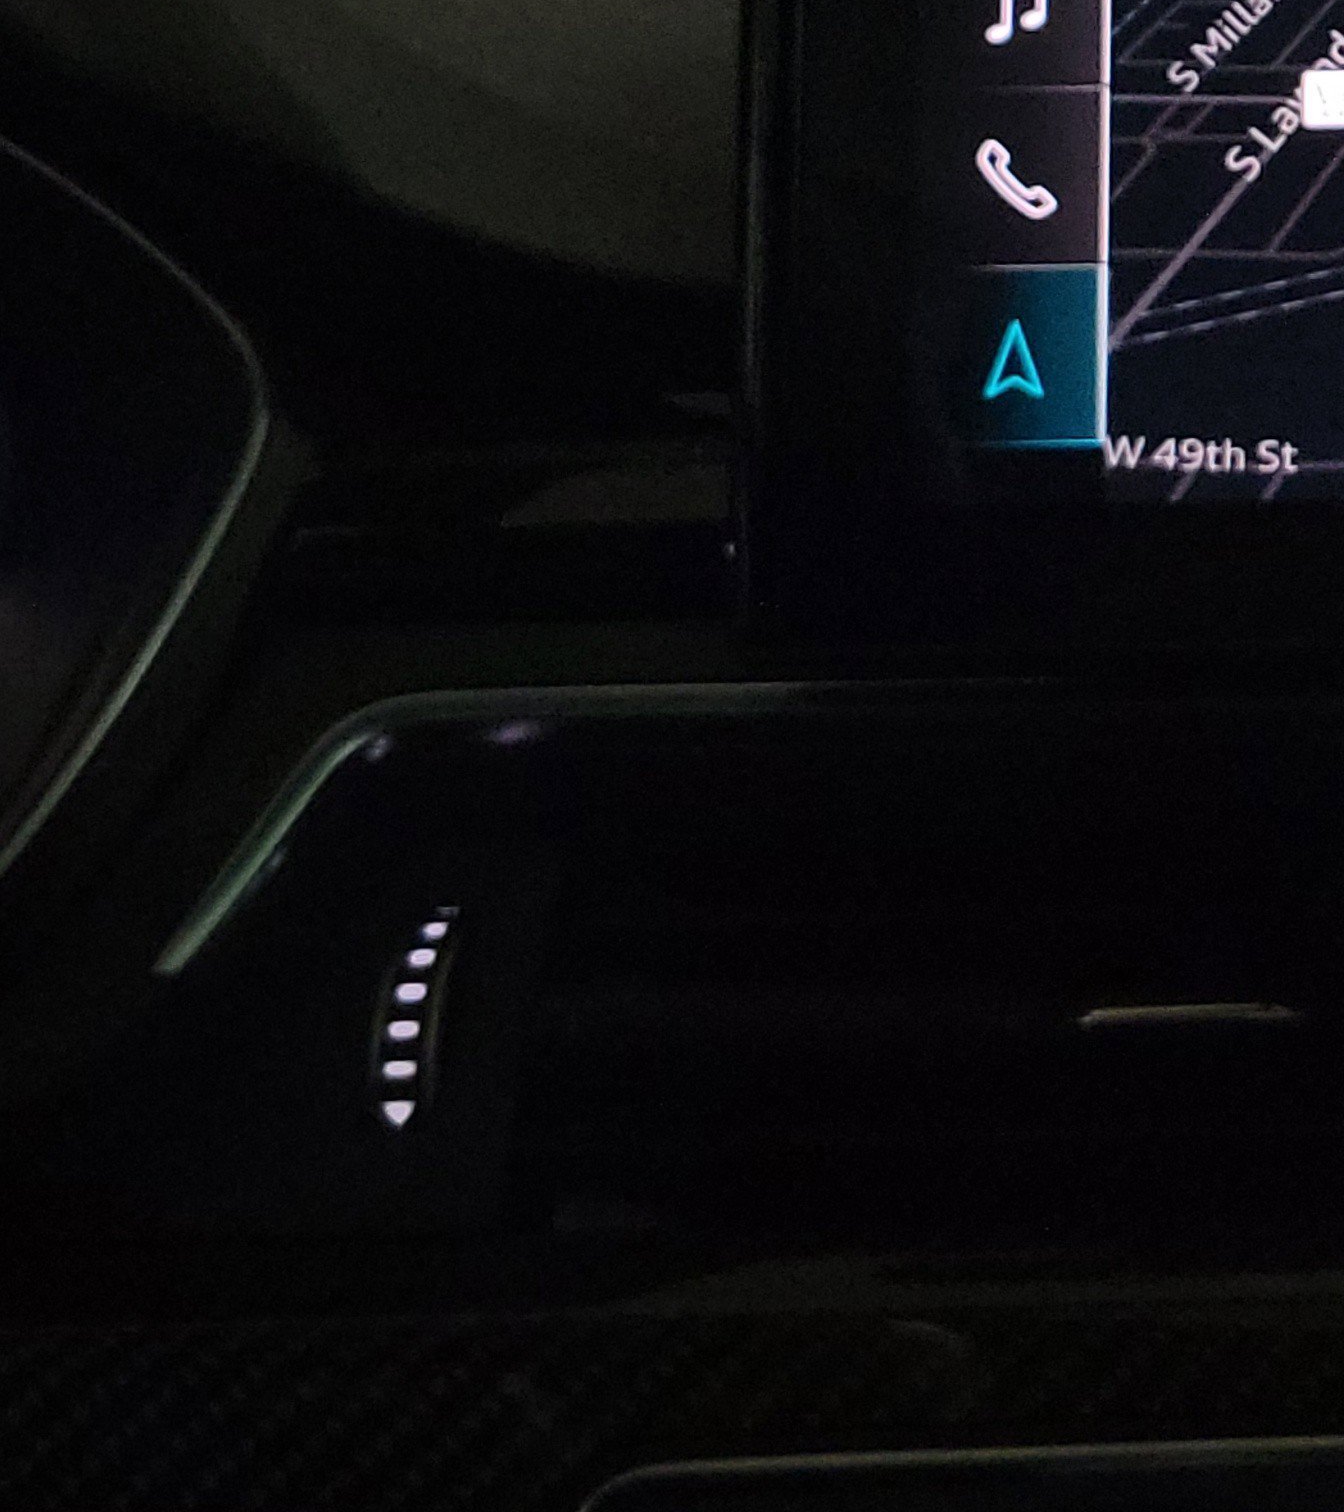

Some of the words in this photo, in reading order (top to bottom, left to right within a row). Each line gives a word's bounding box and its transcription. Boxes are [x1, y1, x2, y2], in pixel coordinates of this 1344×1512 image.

[1166, 60, 1200, 93] S
[1224, 145, 1261, 182] S
[1101, 435, 1146, 470] W
[1151, 437, 1247, 474] 49th
[1256, 439, 1299, 474] St
